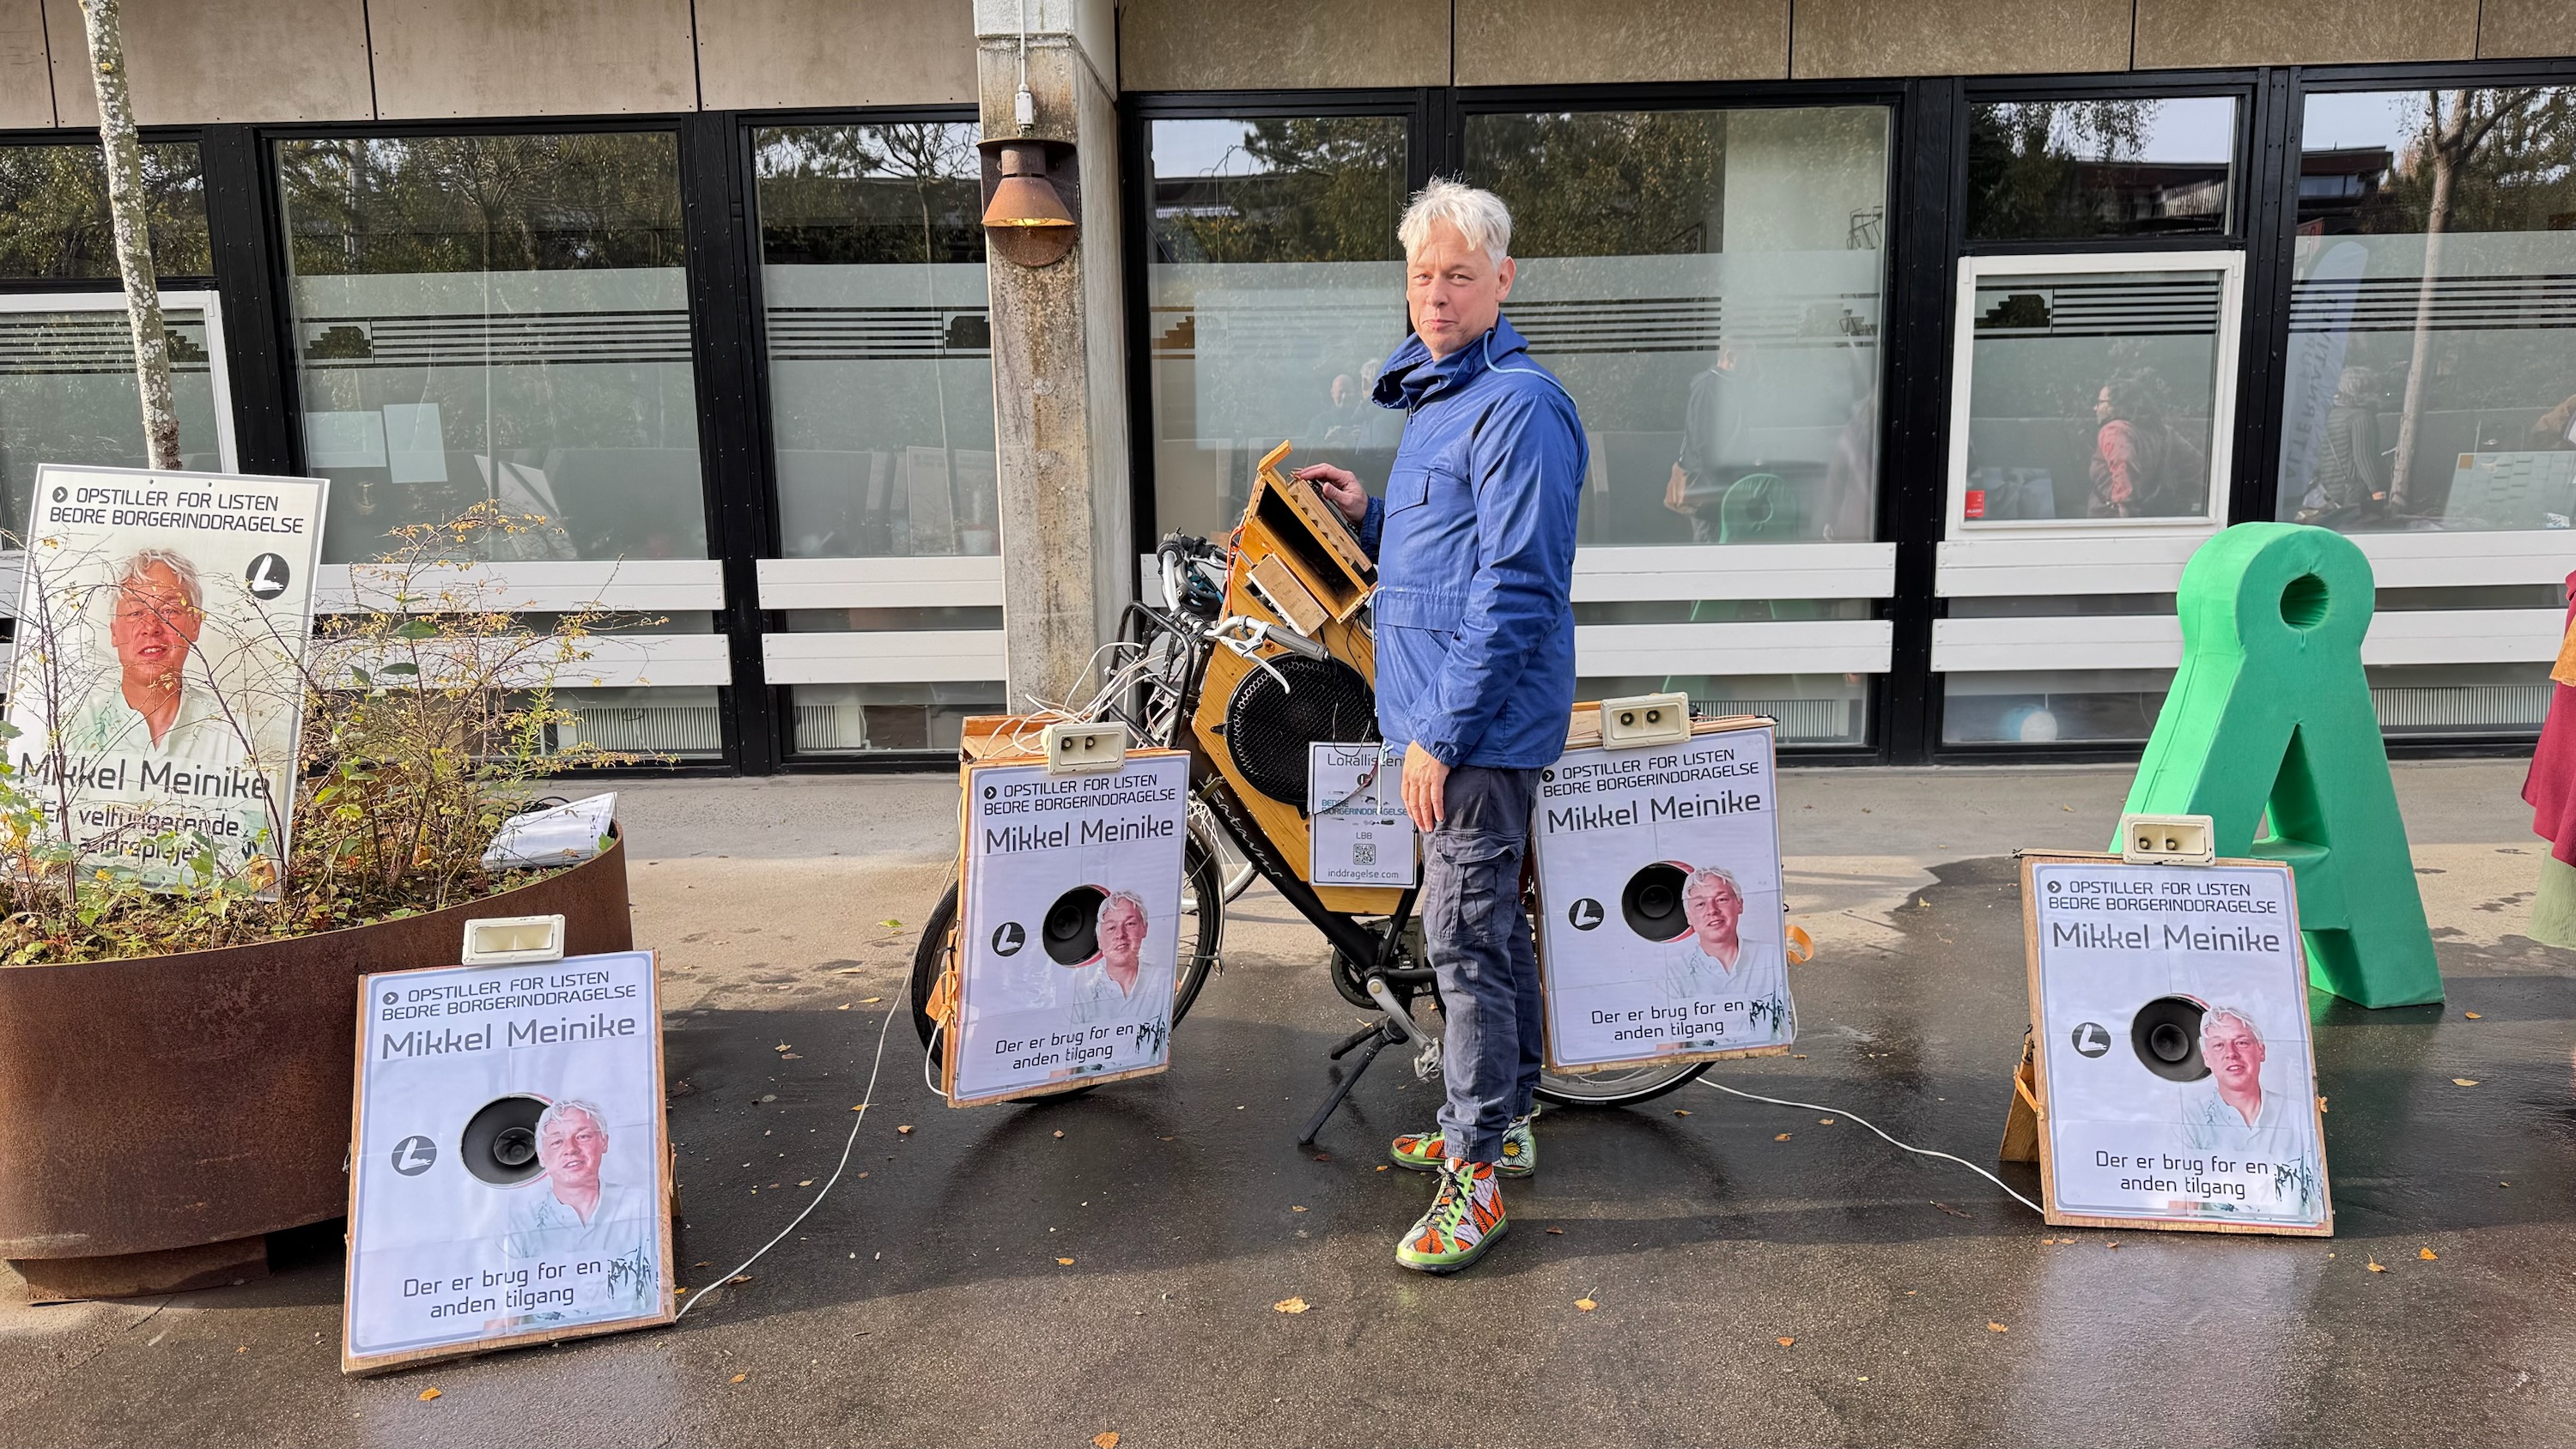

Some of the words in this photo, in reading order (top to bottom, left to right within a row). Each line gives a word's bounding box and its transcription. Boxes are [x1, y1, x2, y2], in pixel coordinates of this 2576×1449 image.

[76, 488, 168, 507] OPSTILLER
[177, 492, 213, 508] FOR
[218, 494, 278, 512] LISTEN
[50, 507, 106, 524] BEDRE
[112, 510, 304, 534] BORGERINDDRAGELSE
[1327, 753, 1402, 767] Lokallisen
[1563, 760, 1641, 780] OPSTILLER
[1649, 755, 1678, 771] FOR
[1684, 749, 1735, 765] LISTEN
[20, 752, 126, 791] Mikkel
[140, 760, 270, 799] Meinike
[1004, 780, 1077, 797] OPSTILLER
[1084, 778, 1109, 791] FOR
[1115, 774, 1157, 788] LISTEN
[1543, 780, 1591, 797] BEDRE
[1597, 761, 1759, 791] BORGERINDDRAGELSE
[984, 800, 1030, 815] BEDRE
[1035, 788, 1176, 811] BORGERINDDRAGELSE
[1547, 800, 1638, 834] Mikkel
[1650, 790, 1760, 822] Meinike
[987, 822, 1069, 854] Mikkel
[1081, 815, 1173, 845] Meinike
[1327, 868, 1399, 880] inddragelse.com
[2069, 881, 2154, 894] OPSTILLER
[2161, 882, 2191, 895] FOR
[2197, 882, 2251, 896] LISTEN
[2049, 897, 2100, 910] BEDRE
[2106, 898, 2277, 914] BORGERINDDRAGELSE
[2053, 922, 2150, 949] Mikkel
[2164, 924, 2280, 952] Meinike
[408, 981, 501, 1003] OPSTILLER
[511, 977, 544, 991] FOR
[550, 971, 610, 987] LISTEN
[382, 1003, 440, 1021] BEDRE
[447, 985, 636, 1015] BORGERINDDRAGELSE
[1591, 1010, 1620, 1024] Der
[1628, 1009, 1643, 1021] er
[1651, 1006, 1687, 1021] brug
[1694, 1002, 1716, 1016] for
[1724, 1001, 1744, 1012] en
[382, 1023, 491, 1059] Mikkel
[507, 1013, 635, 1046] Meinike
[995, 1040, 1023, 1054] Der
[1030, 1037, 1045, 1048] er
[1051, 1032, 1084, 1047] brug
[1090, 1027, 1109, 1040] for
[1116, 1024, 1133, 1035] en
[1614, 1025, 1663, 1040] anden
[1671, 1021, 1724, 1039] tilgang
[1013, 1052, 1059, 1070] anden
[1066, 1045, 1113, 1064] tilgang
[2096, 1150, 2128, 1168] Der
[2136, 1156, 2154, 1169] er
[2163, 1154, 2203, 1176] brug
[2212, 1156, 2236, 1173] for
[2246, 1161, 2269, 1174] en
[2121, 1175, 2177, 1192] anden
[2185, 1177, 2245, 1200] tilgang
[404, 1278, 442, 1297] Der
[452, 1276, 473, 1291] er
[483, 1269, 528, 1288] brug
[538, 1262, 567, 1280] for
[577, 1260, 601, 1275] en
[430, 1294, 495, 1318] anden
[507, 1288, 574, 1311] tilgang
